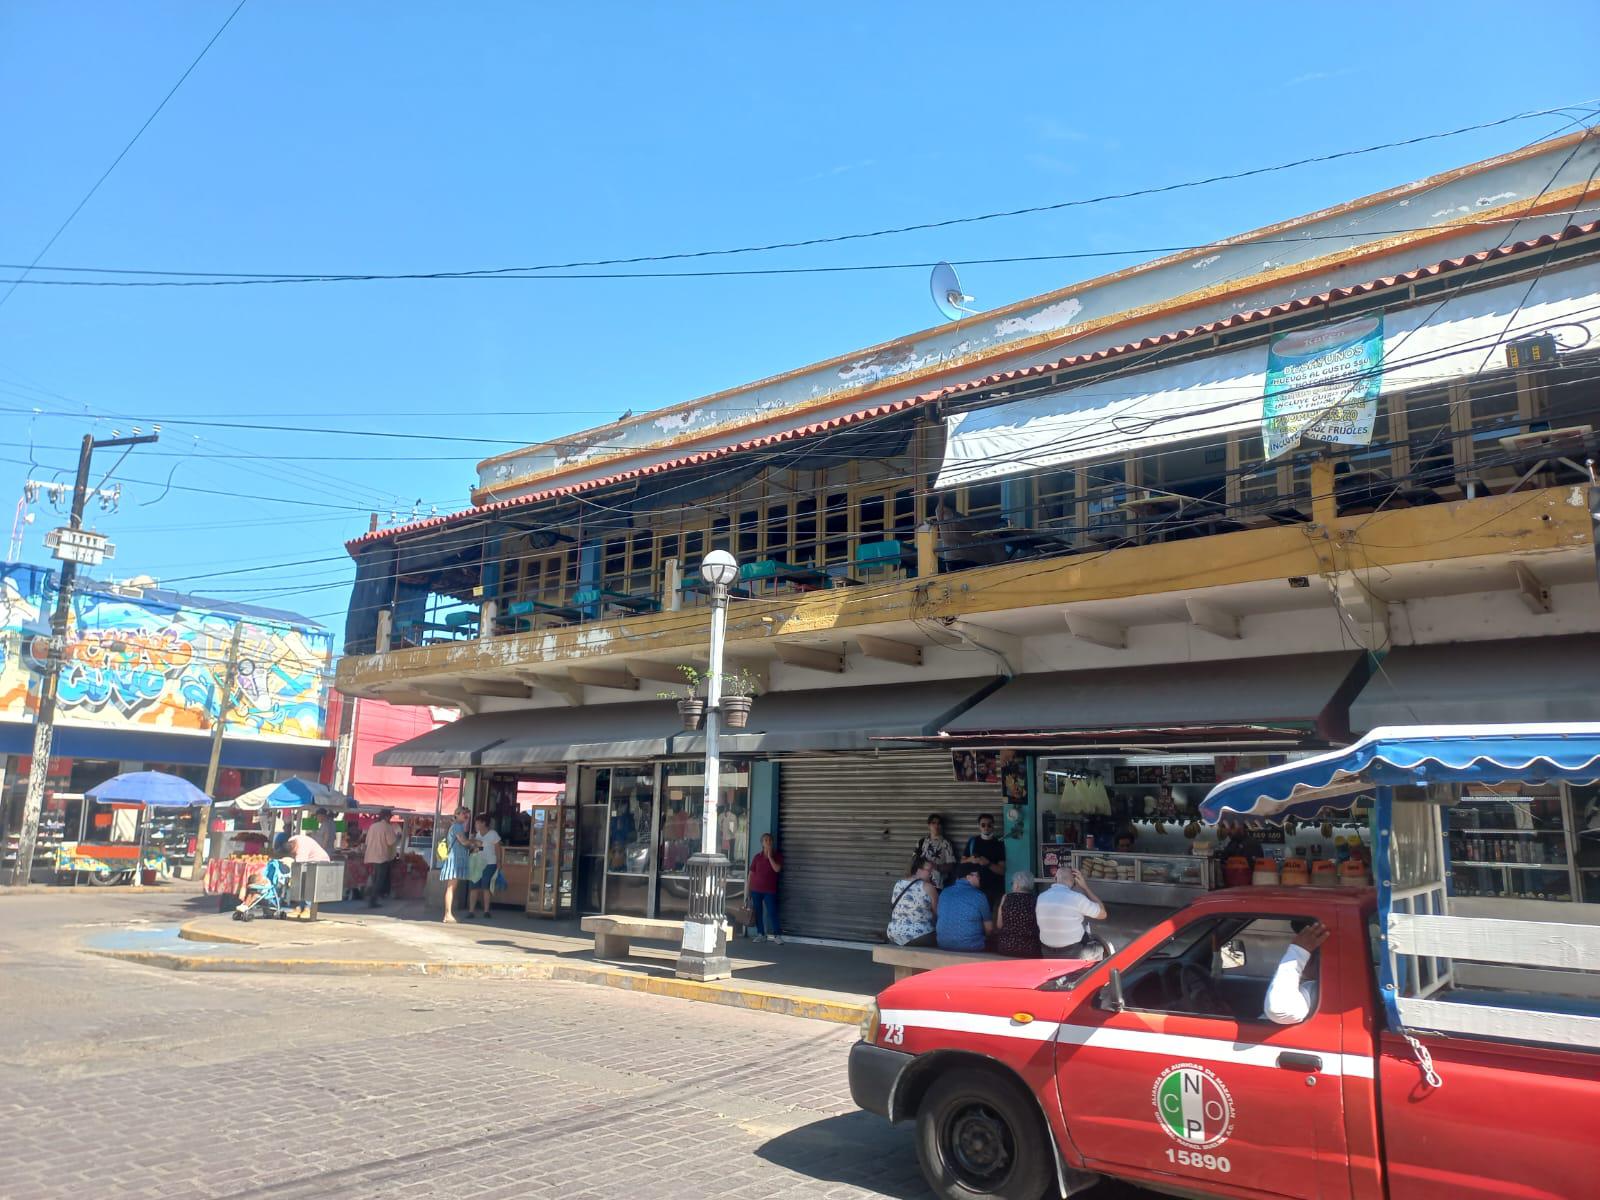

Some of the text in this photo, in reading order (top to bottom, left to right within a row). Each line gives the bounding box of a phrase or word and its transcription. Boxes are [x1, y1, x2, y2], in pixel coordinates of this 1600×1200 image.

[1273, 373, 1307, 385] HUEVOS
[1309, 370, 1320, 378] AL
[1322, 363, 1351, 376] GUSTO
[1270, 432, 1300, 451] INCLUYE
[1328, 425, 1368, 435] FRIJOLES
[883, 1024, 904, 1045] 23
[1151, 1077, 1163, 1106] ALIANZA
[1161, 1068, 1171, 1077] DE
[1171, 1062, 1204, 1072] AURIGAS
[1204, 1068, 1216, 1079] DE
[1215, 1077, 1236, 1119] MAZATLAN
[1165, 1148, 1231, 1173] 15890
